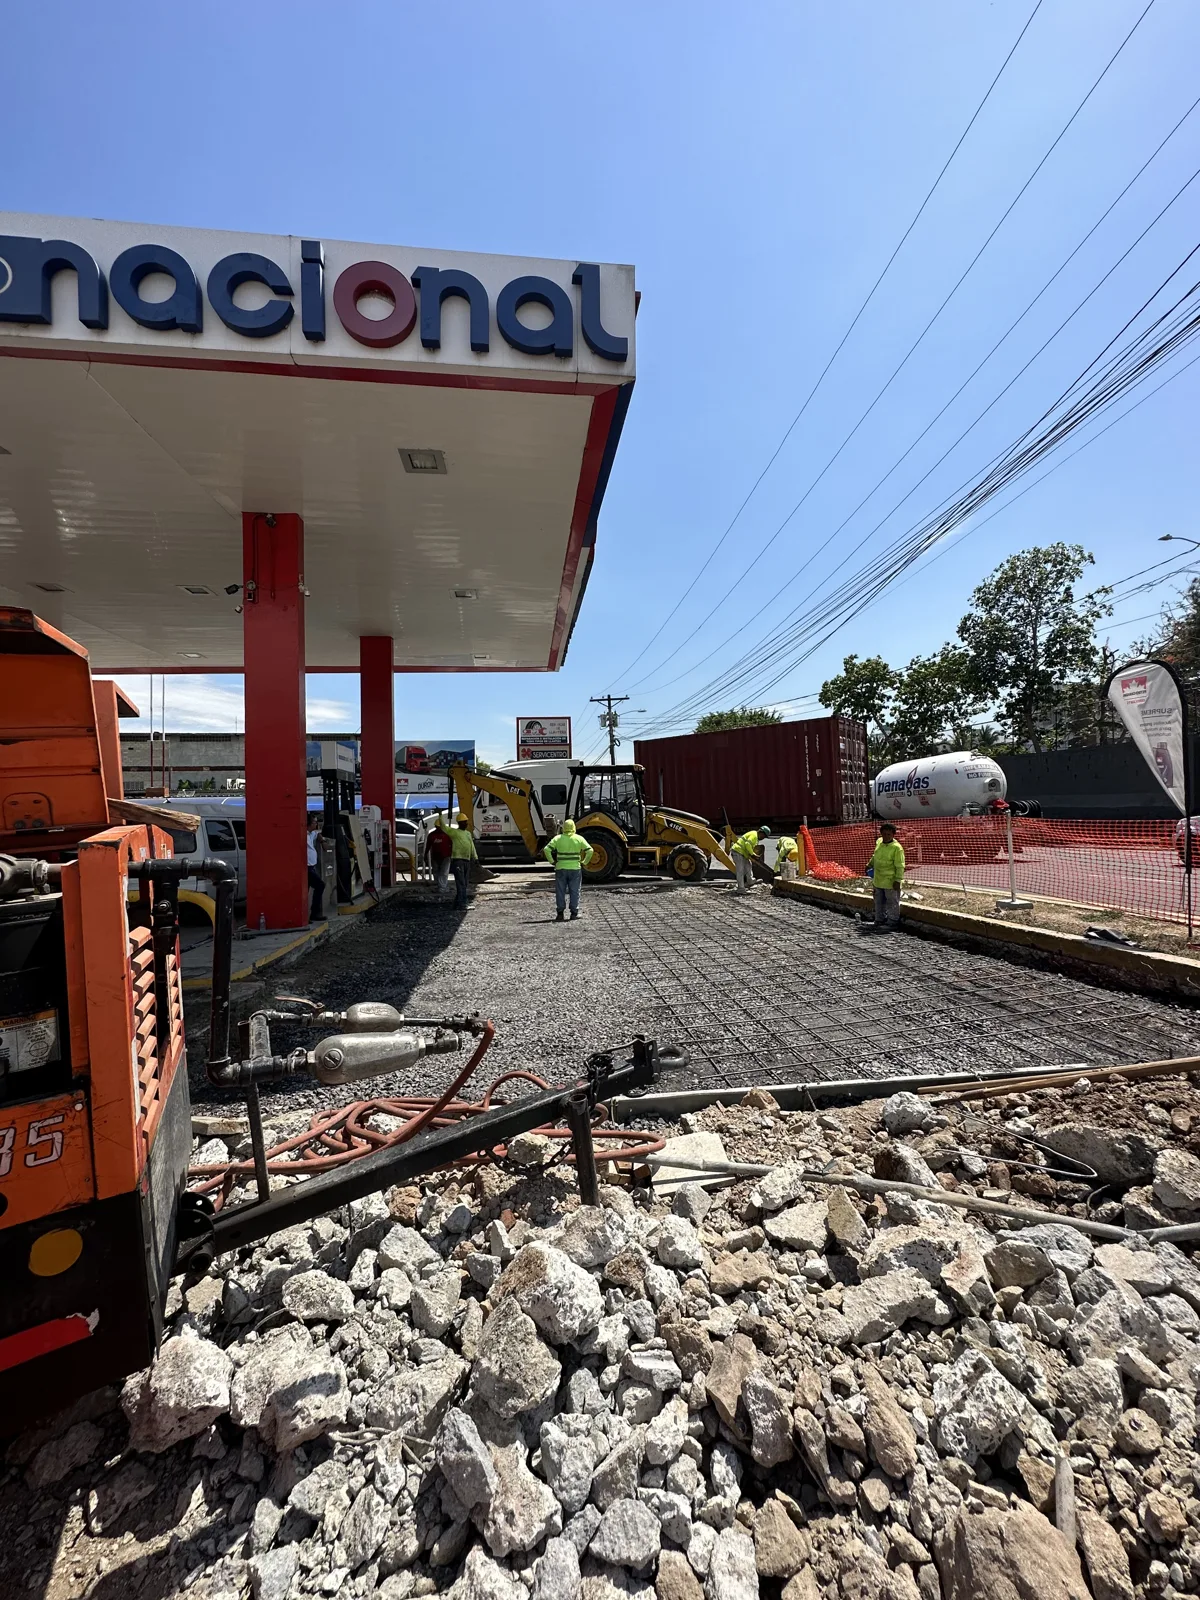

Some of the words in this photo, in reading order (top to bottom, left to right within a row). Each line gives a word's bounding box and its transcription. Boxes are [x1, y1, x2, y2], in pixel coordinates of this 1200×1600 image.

[510, 786, 520, 794] CAT
[877, 776, 930, 797] panagas
[669, 822, 682, 832] 416E
